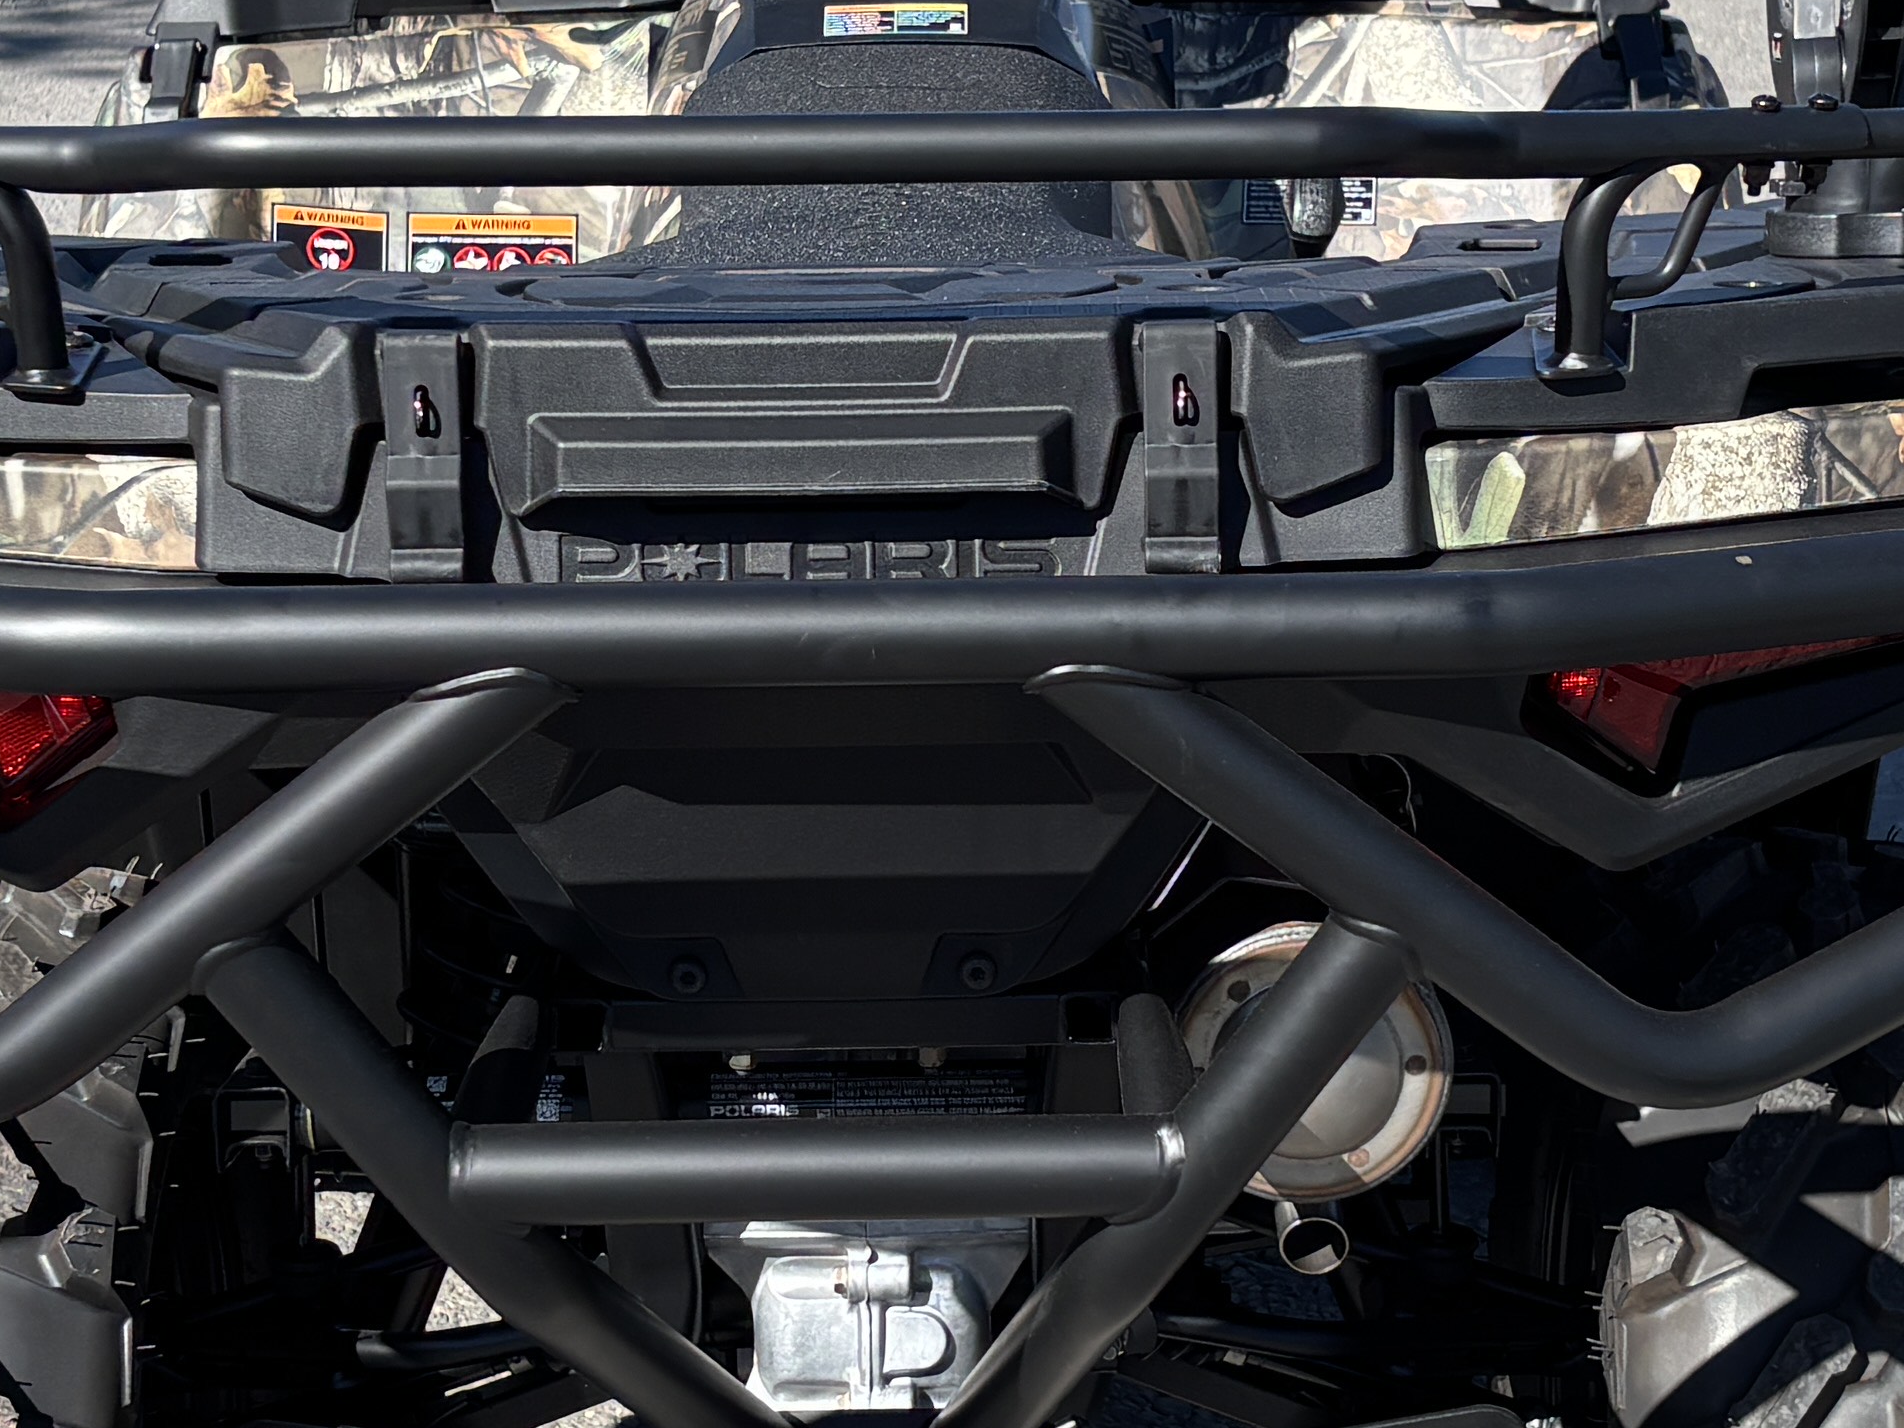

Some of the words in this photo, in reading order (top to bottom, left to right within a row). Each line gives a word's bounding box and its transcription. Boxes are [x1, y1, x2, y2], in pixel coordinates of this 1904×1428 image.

[307, 211, 365, 226] WARNING
[471, 219, 532, 230] WARNING
[560, 535, 1063, 582] POLARIS
[709, 1104, 800, 1117] POLARIS
